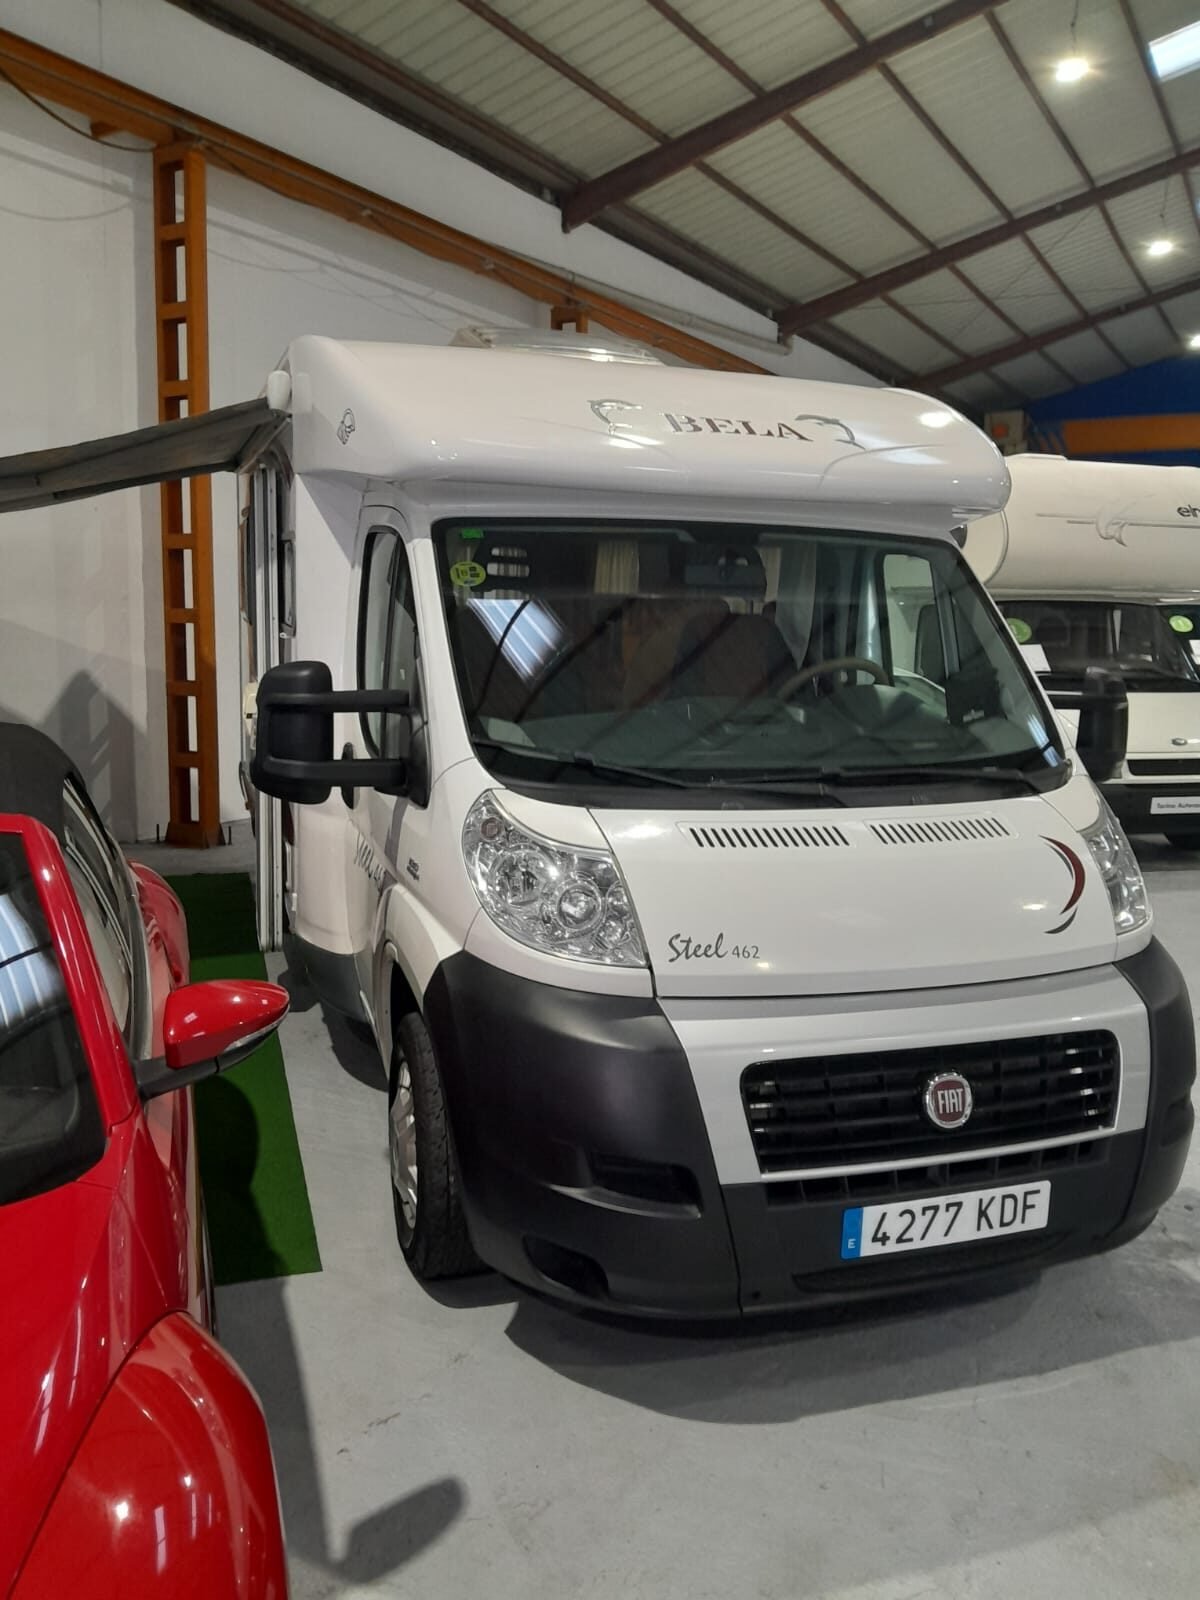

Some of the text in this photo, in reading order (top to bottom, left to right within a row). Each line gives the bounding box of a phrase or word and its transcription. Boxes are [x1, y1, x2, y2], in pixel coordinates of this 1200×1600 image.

[661, 413, 814, 442] BELA
[668, 932, 760, 962] Steel 462
[937, 1088, 963, 1114] FIAT
[871, 1189, 1041, 1246] 4277 KDF
[848, 1238, 856, 1249] E
